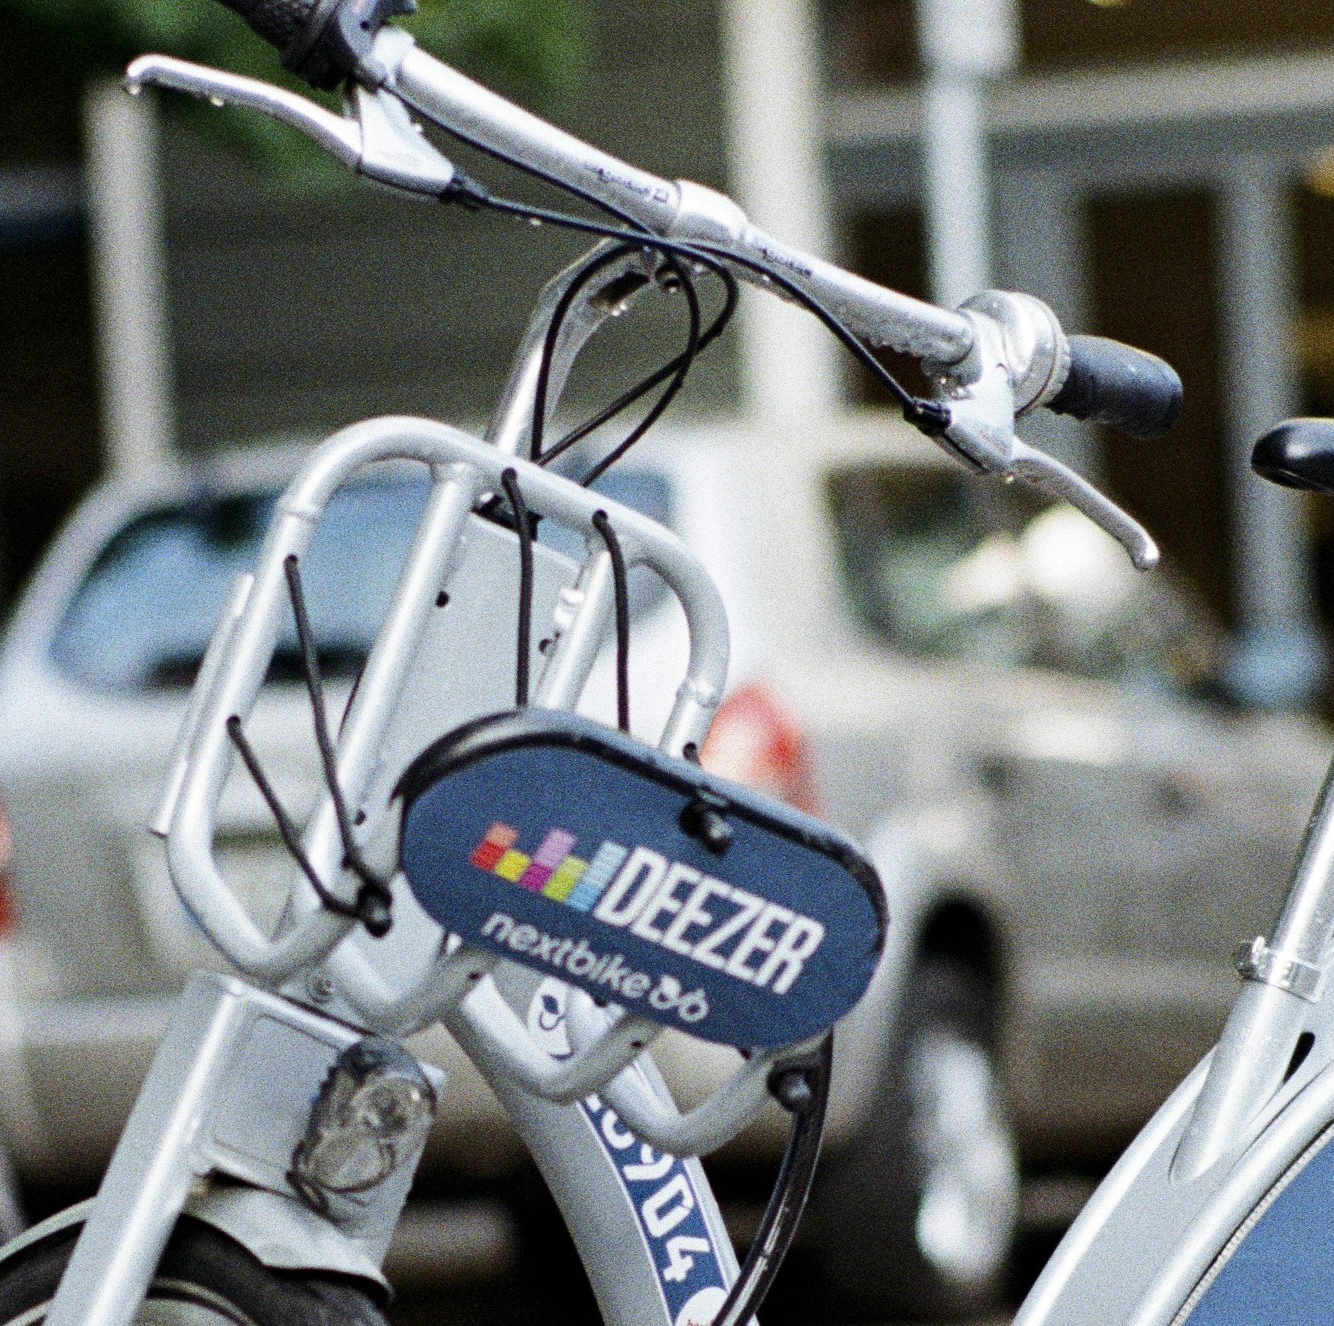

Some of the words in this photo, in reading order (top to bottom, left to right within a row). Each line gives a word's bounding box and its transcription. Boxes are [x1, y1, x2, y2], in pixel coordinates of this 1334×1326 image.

[480, 911, 651, 999] nextbike
[594, 846, 825, 995] DEEZER
[585, 1093, 712, 1282] 904
